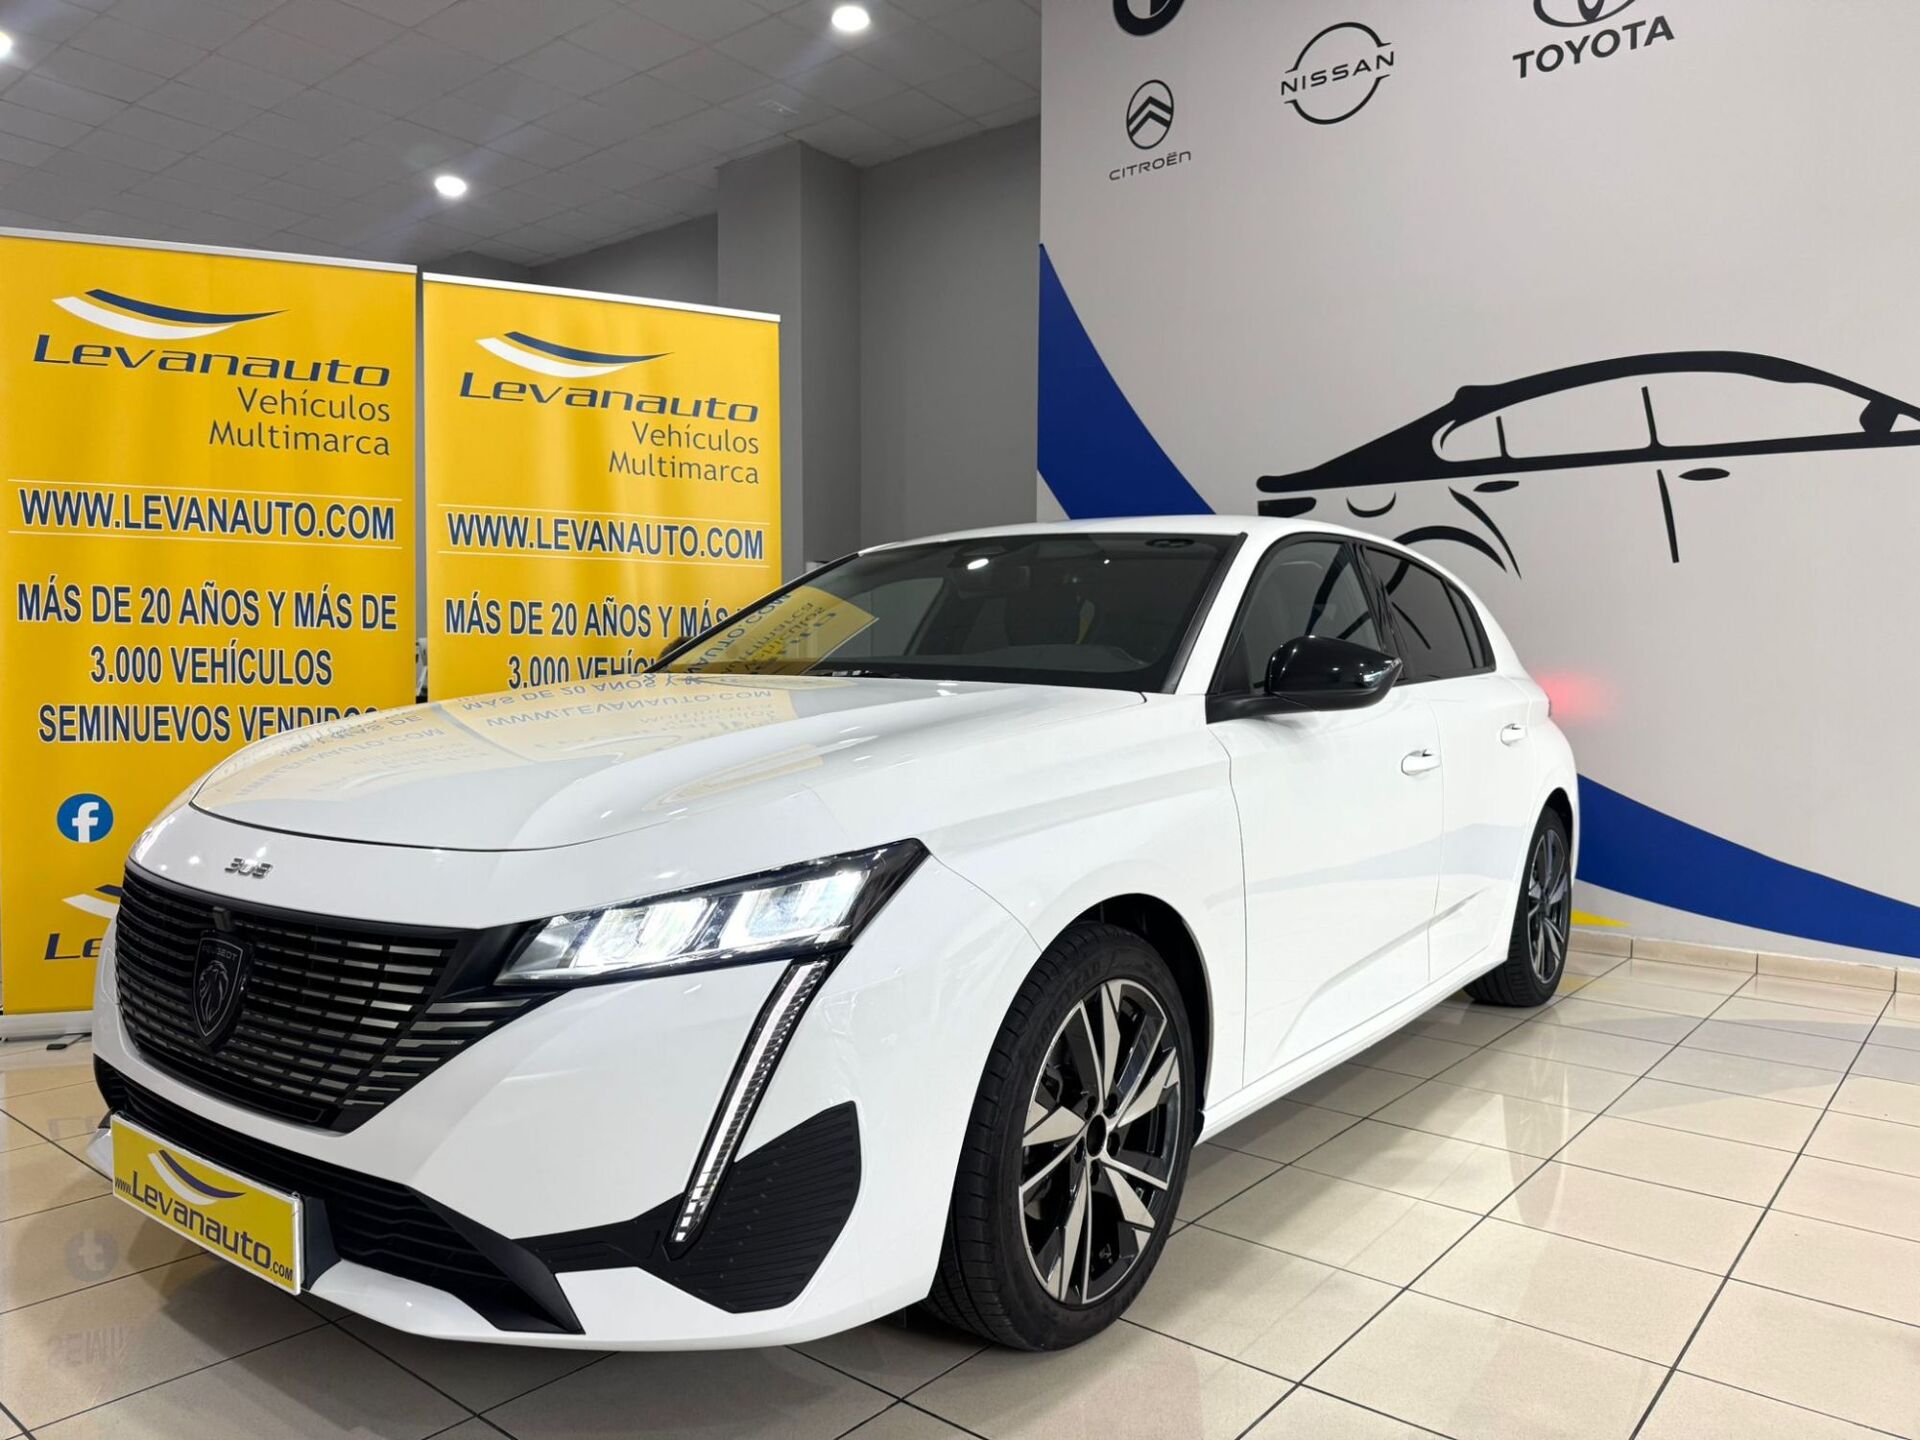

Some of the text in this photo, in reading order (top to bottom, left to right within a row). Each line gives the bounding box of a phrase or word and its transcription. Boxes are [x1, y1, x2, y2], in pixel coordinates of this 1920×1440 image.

[1512, 15, 1675, 79] TOYOTA
[1280, 51, 1395, 95] NISSAN
[33, 334, 391, 388] Levanauto
[237, 386, 391, 422] Vehículos
[459, 372, 759, 423] Levanauto
[208, 419, 391, 456] Multimarca
[631, 420, 760, 454] Vehículos
[608, 450, 760, 484] Multimarca
[18, 488, 396, 541] WWW.LEVANAUTO.COM
[447, 512, 764, 560] WWW.LEVANAUTO.COM
[17, 575, 397, 630] MÁS DE 20 AÑOS Y MÁS DE
[445, 591, 501, 635] MÁS
[509, 600, 543, 636] DE
[551, 602, 578, 637] 20
[584, 597, 652, 638] AÑOS
[658, 606, 674, 638] Y
[90, 639, 333, 686] 3.000 VEHÍCULOS
[508, 655, 570, 689] 3.000
[39, 704, 230, 743] SEMINUEVOS
